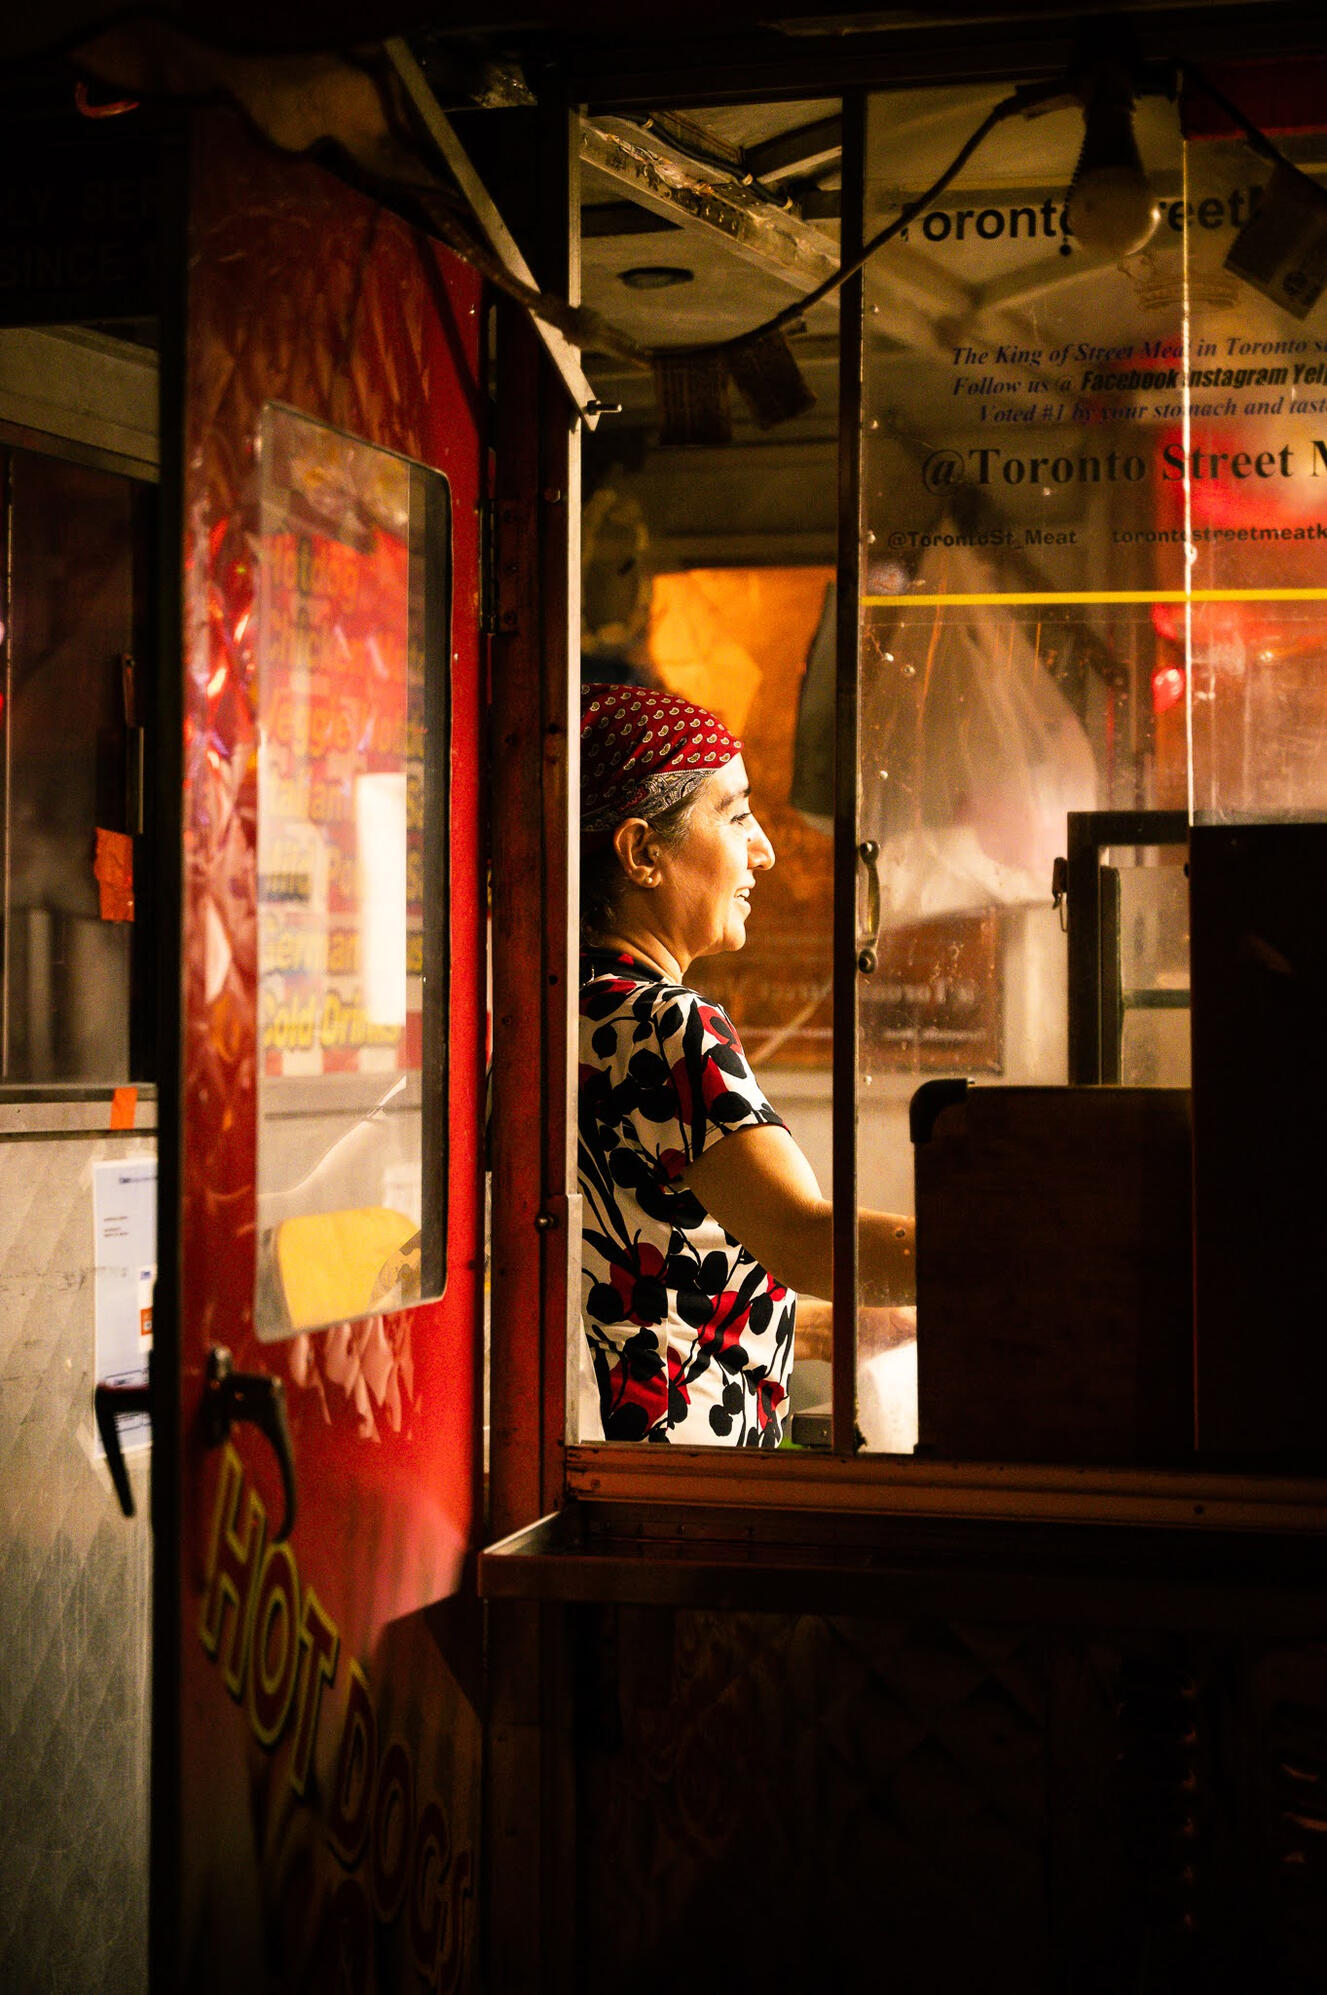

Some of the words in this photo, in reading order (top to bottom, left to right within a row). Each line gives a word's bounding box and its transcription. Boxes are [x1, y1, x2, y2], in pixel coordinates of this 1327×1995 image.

[952, 346, 989, 365] The
[995, 344, 1043, 367] King
[1048, 343, 1074, 367] of
[1074, 342, 1134, 362] Street
[1140, 340, 1190, 360] Mea
[1196, 338, 1218, 357] in
[1225, 337, 1308, 357] Toronto
[953, 376, 1022, 396] Follow
[1028, 379, 1049, 393] us
[1081, 369, 1179, 391] Facebook
[1183, 365, 1289, 389] nstagram
[980, 403, 1037, 423] Voted
[1042, 402, 1065, 421] #1
[1073, 401, 1092, 424] by
[1100, 405, 1148, 425] your
[1243, 396, 1285, 416] and
[922, 448, 1146, 496] @Toronto
[1162, 442, 1294, 481] Street
[887, 528, 1077, 550] @TorontoSt_Meat
[201, 1438, 341, 1802] HOT
